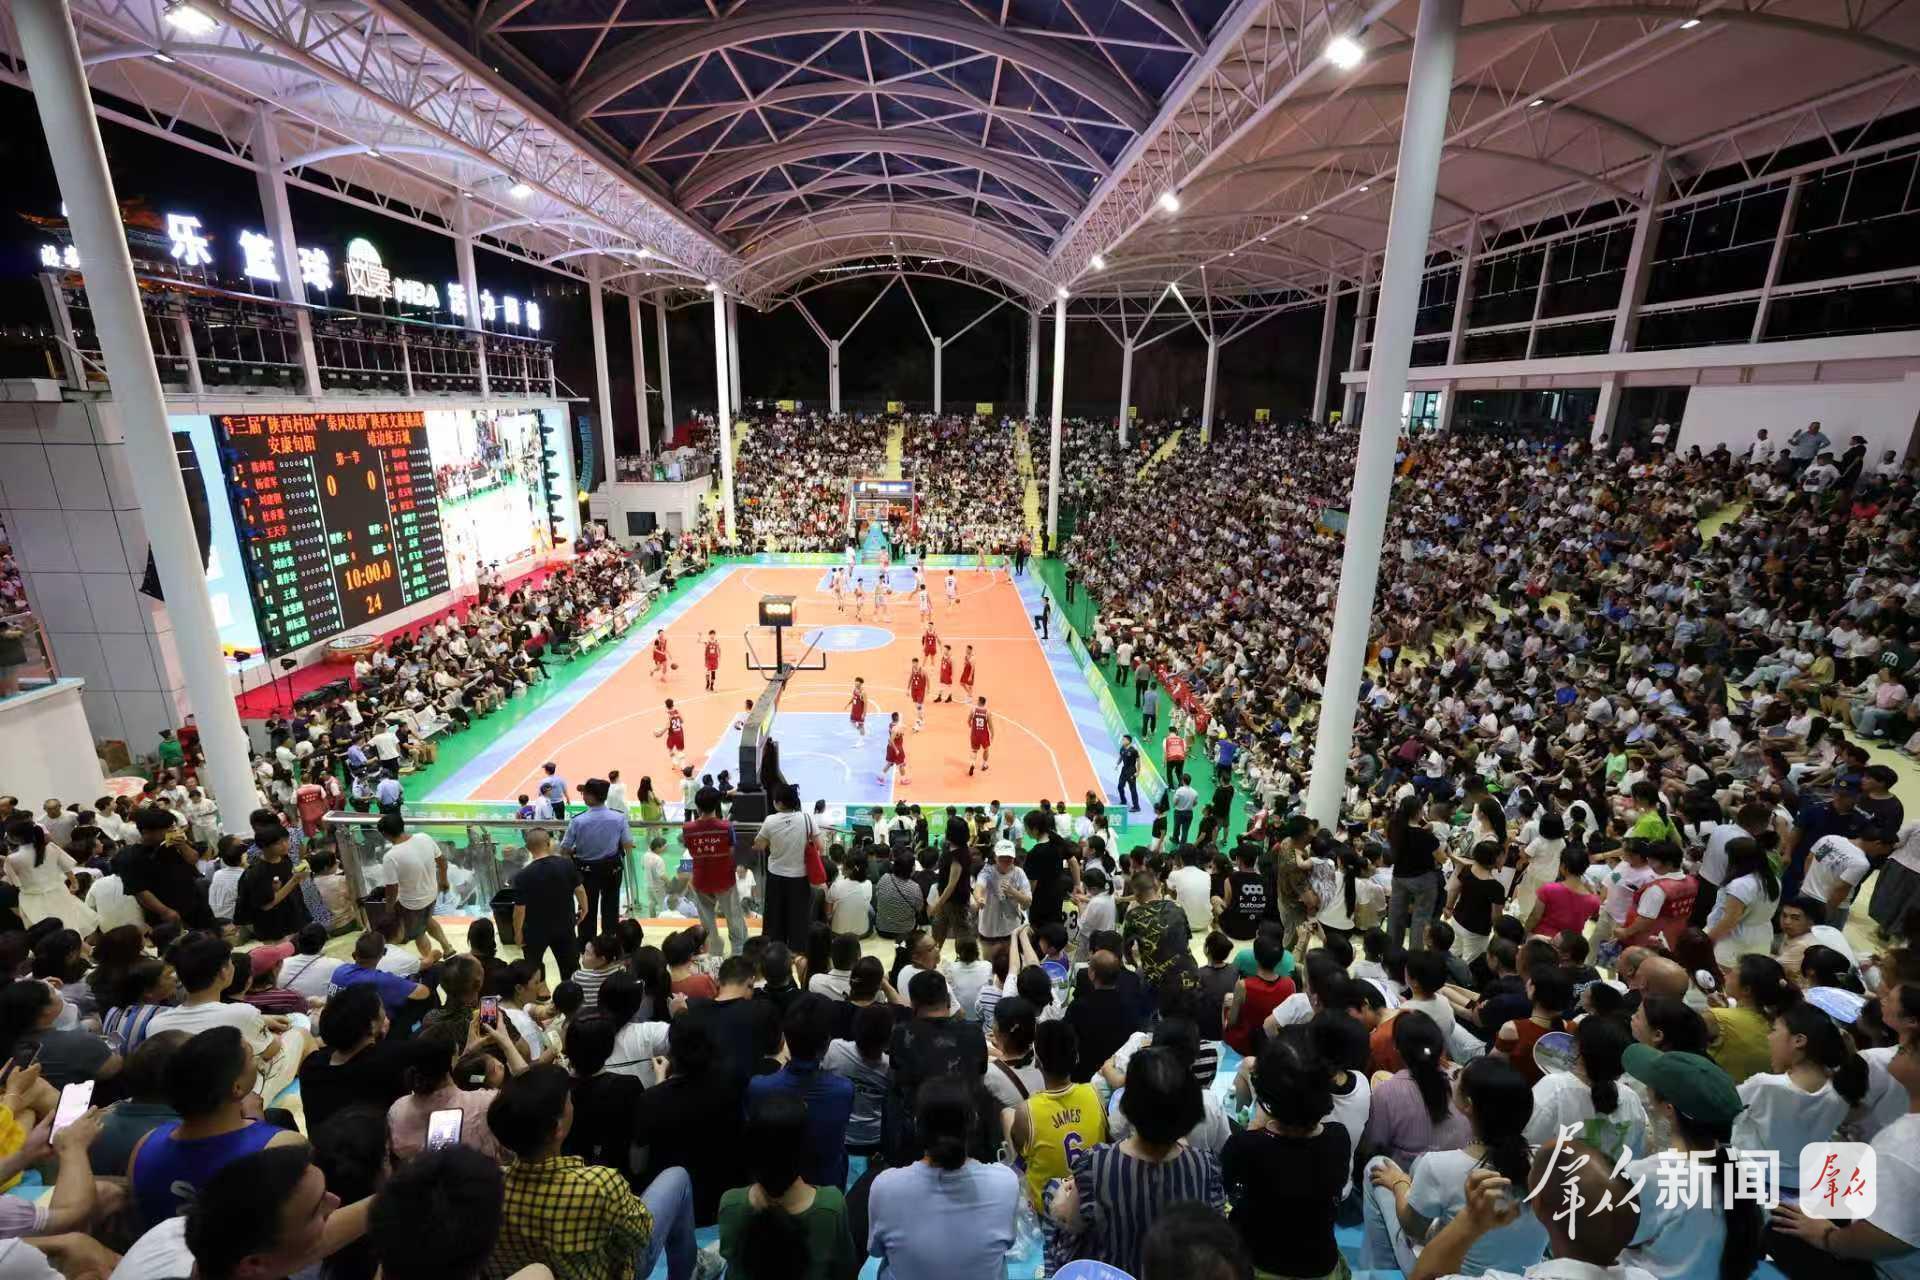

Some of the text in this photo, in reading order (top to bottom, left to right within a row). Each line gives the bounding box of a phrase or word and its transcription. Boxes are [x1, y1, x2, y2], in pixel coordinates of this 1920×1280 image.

[267, 434, 316, 454] 安康旬阳
[326, 475, 337, 497] 0
[367, 470, 376, 490] 0
[345, 559, 391, 590] 10:00.0
[366, 592, 382, 614] 24
[1050, 1108, 1081, 1129] JAMES
[1064, 1132, 1083, 1170] 6
